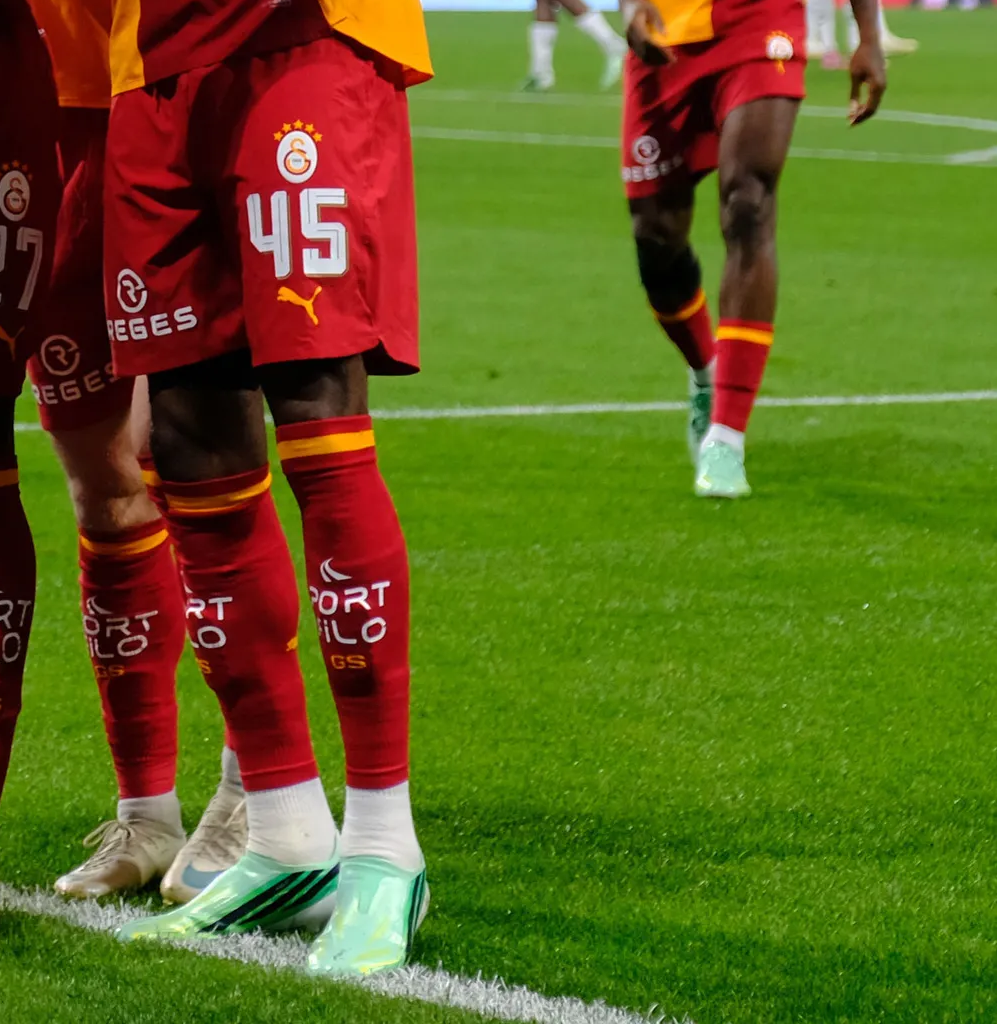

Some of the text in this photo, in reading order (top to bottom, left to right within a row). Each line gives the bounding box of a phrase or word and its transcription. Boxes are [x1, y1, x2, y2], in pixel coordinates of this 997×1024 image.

[246, 188, 348, 280] 45
[82, 609, 159, 638] ORT
[330, 654, 367, 670] GS
